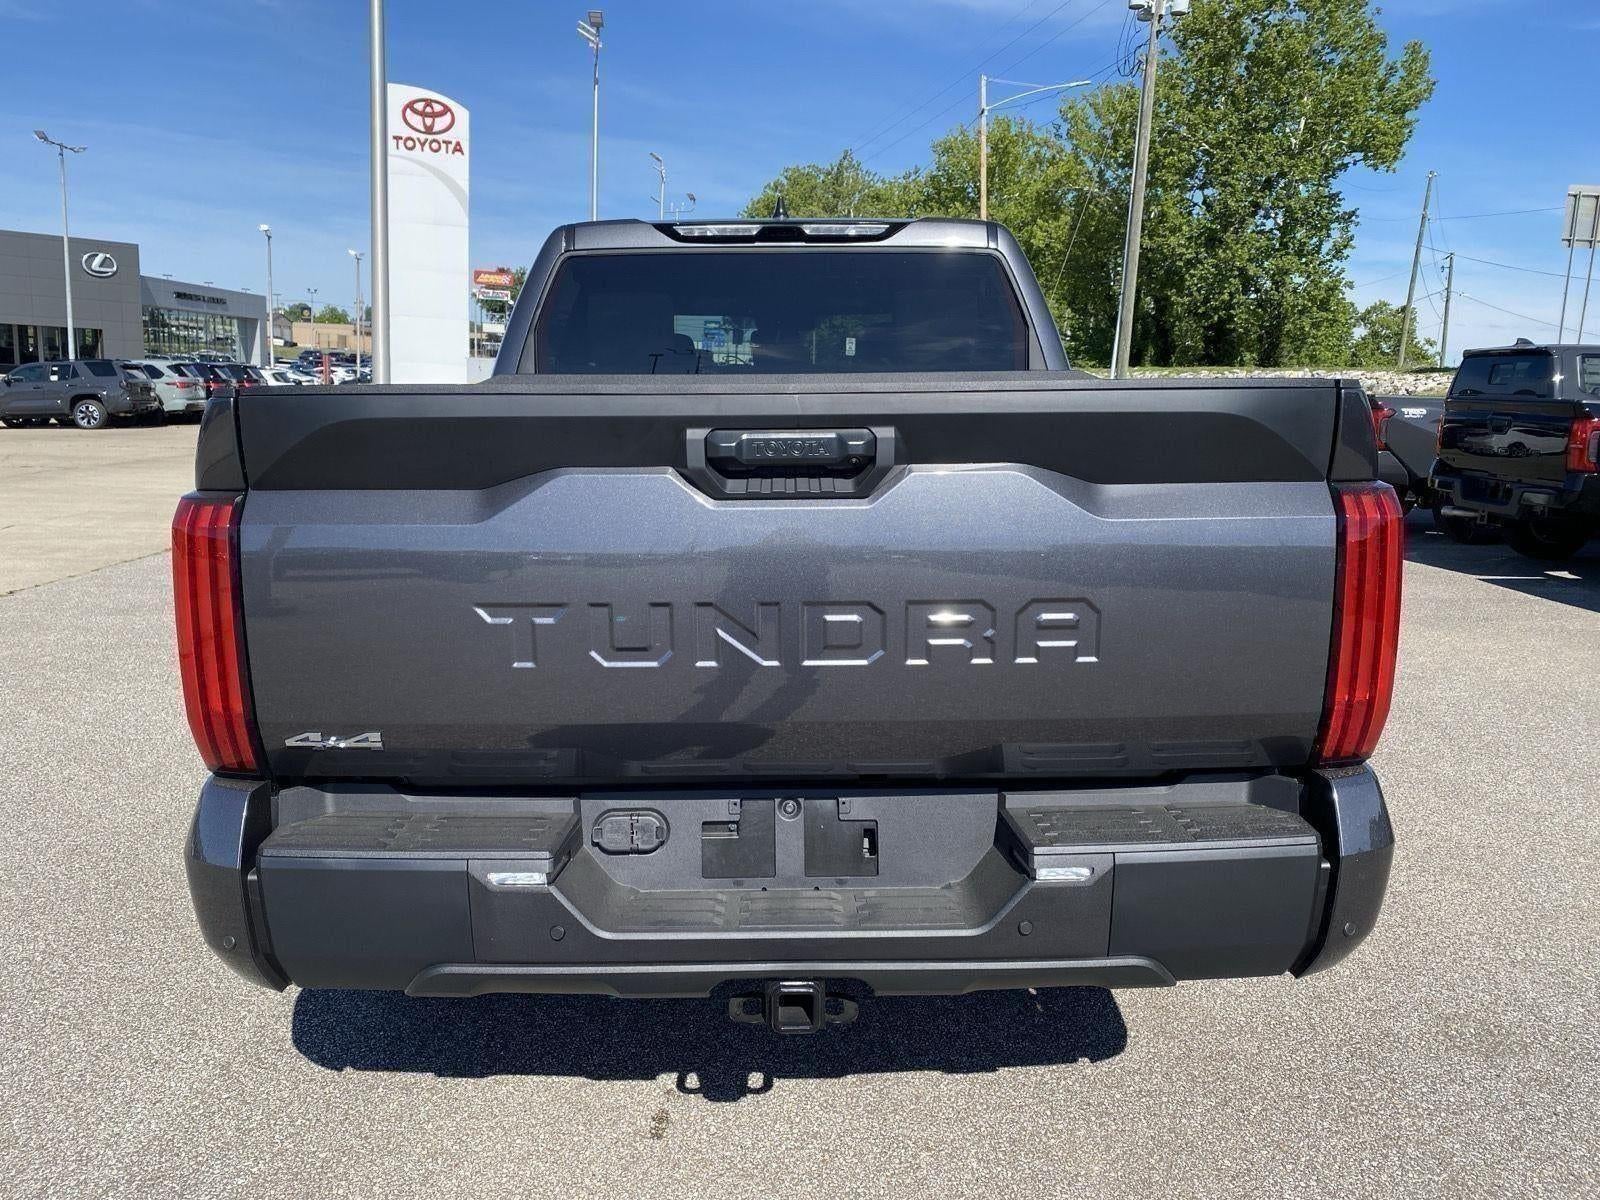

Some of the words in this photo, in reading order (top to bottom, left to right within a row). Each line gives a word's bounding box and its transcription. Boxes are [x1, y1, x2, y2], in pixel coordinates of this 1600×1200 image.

[392, 135, 465, 155] TOYOTA
[752, 440, 831, 457] TOYOTA
[472, 597, 1102, 669] TUNDRA
